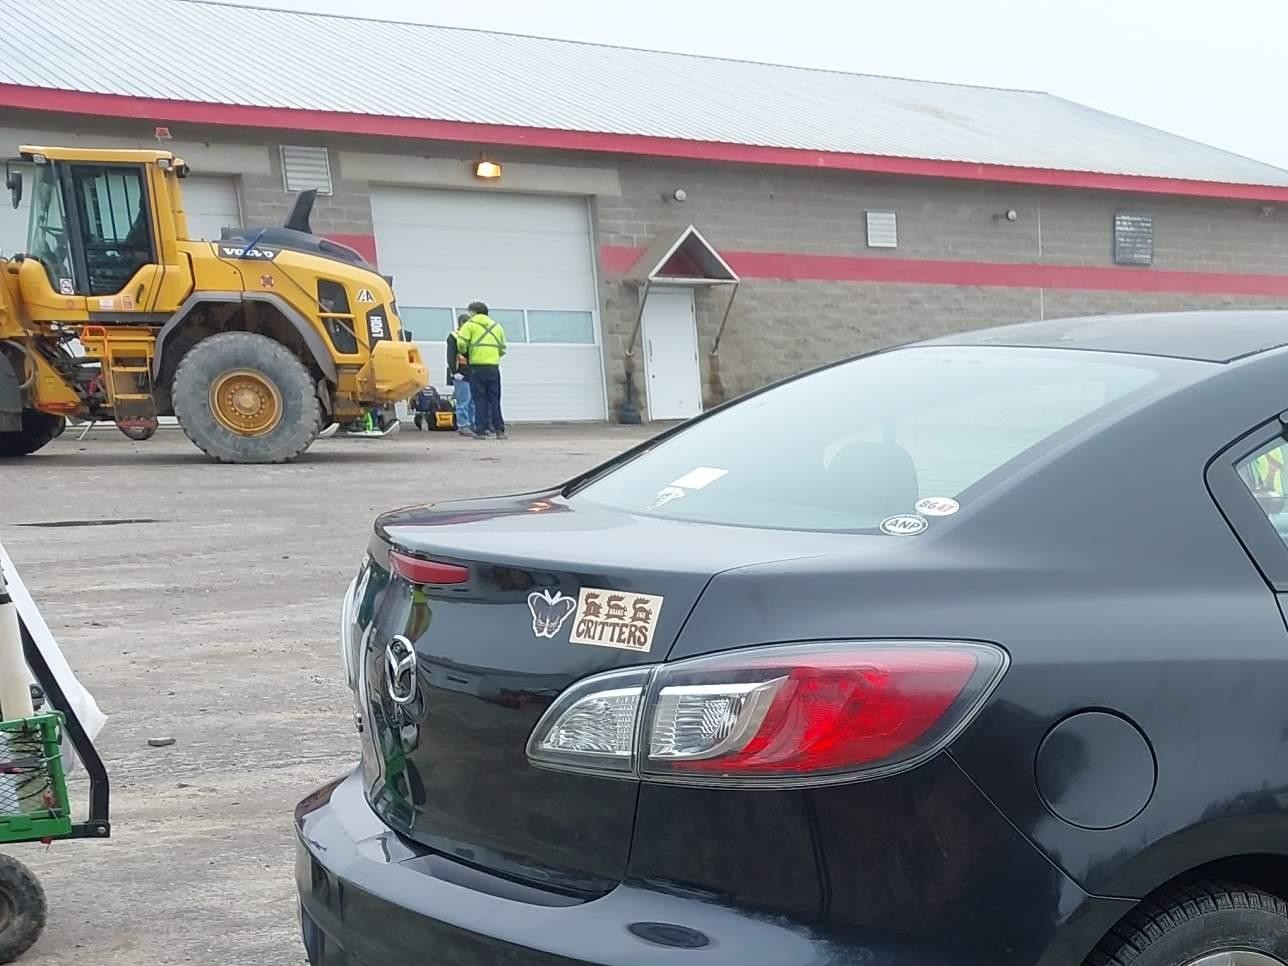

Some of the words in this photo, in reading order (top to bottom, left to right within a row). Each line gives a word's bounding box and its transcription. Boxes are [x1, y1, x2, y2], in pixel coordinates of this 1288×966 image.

[222, 247, 274, 258] VOLVO
[919, 500, 954, 512] 8647
[887, 519, 921, 530] ANP
[576, 619, 649, 647] CRITTERS
